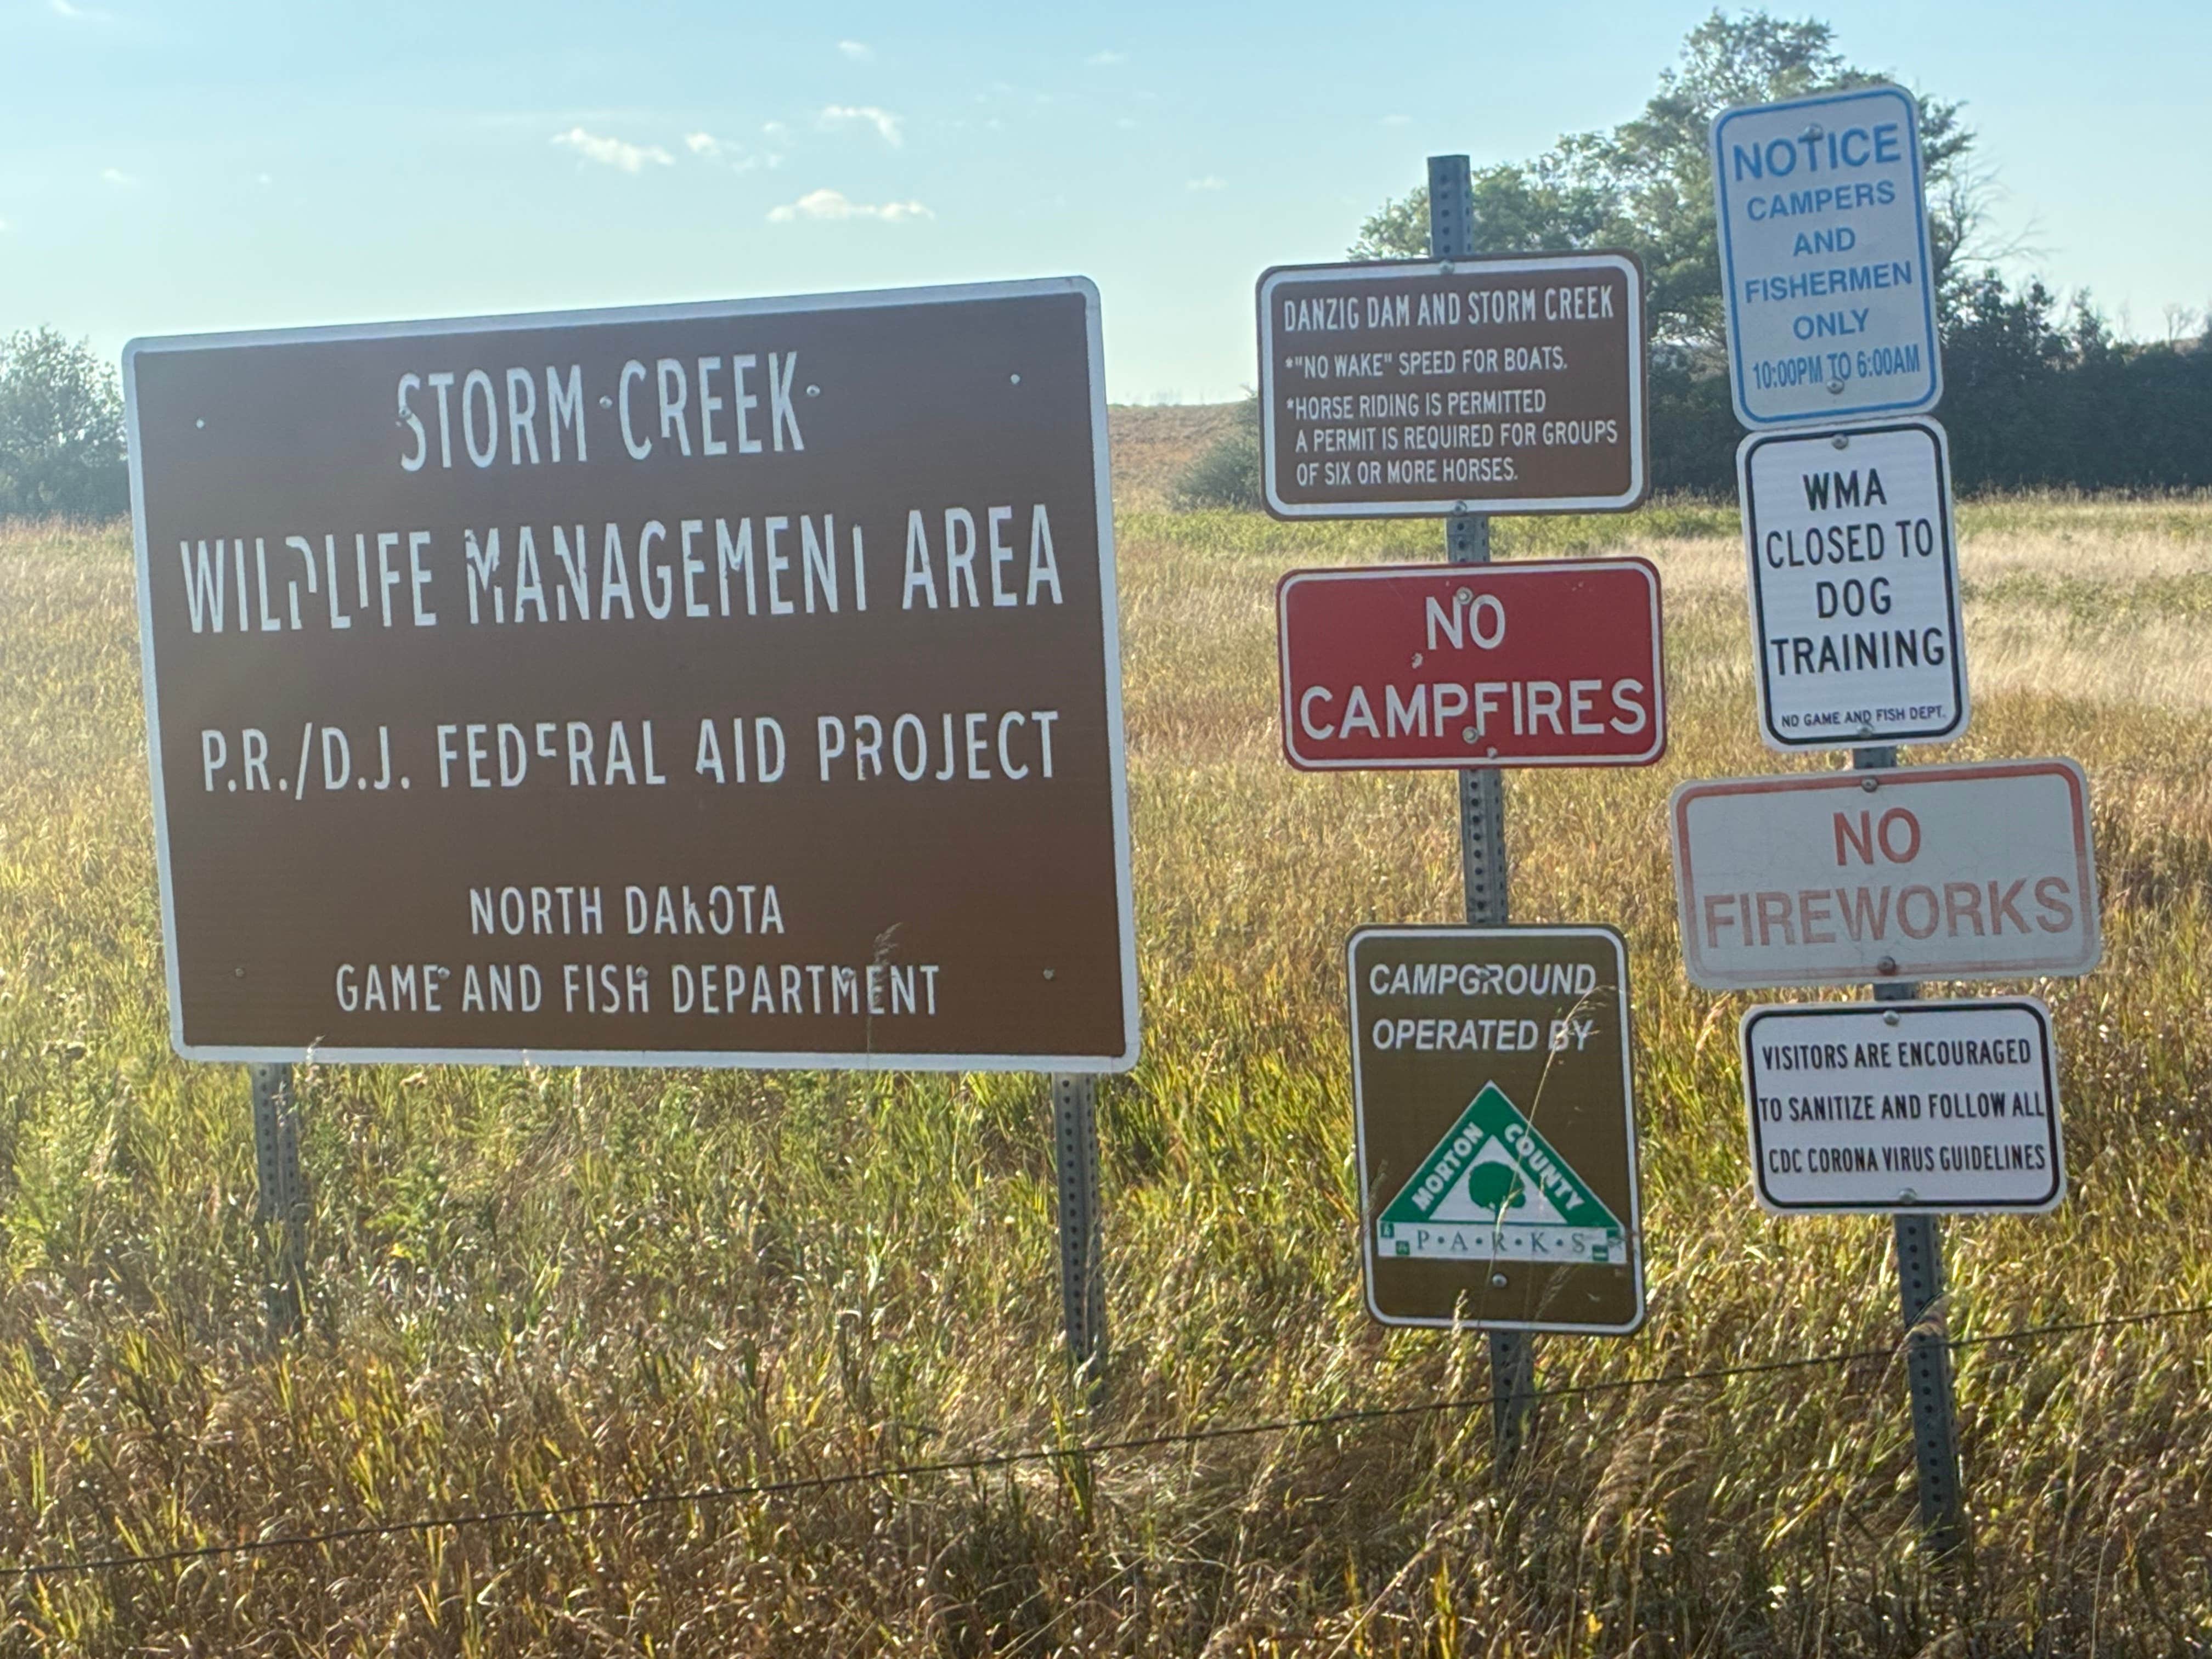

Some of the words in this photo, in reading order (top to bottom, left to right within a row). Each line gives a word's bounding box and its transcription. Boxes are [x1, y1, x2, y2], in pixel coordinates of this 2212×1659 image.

[1733, 123, 1901, 182] NOTICE
[1747, 180, 1895, 221] CAMPERS
[1793, 227, 1856, 256] AND
[1745, 261, 1912, 303] FISHERMEN
[1284, 297, 1358, 331] DANZIG
[1368, 294, 1409, 328] DAM
[1418, 292, 1460, 325] AND
[1469, 289, 1536, 324] STORM
[1545, 285, 1613, 320] CREEK
[1793, 308, 1869, 340] ONLY
[1334, 353, 1392, 377] WAKE"
[1399, 350, 1455, 376] SPEED
[1463, 348, 1497, 373] FOR
[1504, 346, 1567, 371] BOATS.
[1753, 356, 1822, 389] 10:00PM
[1827, 351, 1851, 381] TO
[1857, 344, 1920, 377] 6:00AM
[398, 364, 588, 472] STORM
[619, 351, 805, 461] CREEK
[1360, 393, 1419, 417] RIDING
[1426, 392, 1441, 415] IS
[1448, 390, 1545, 415] PERMITTED
[1296, 430, 1308, 452] A
[1314, 427, 1375, 452] PERMIT
[1383, 426, 1398, 450] IS
[1404, 424, 1493, 450] REQUIRED
[1501, 422, 1536, 447] FOR
[1542, 419, 1618, 445] GROUPS
[1296, 463, 1319, 486] OF
[1324, 462, 1351, 485] SIX
[1357, 461, 1380, 484] OR
[1388, 459, 1437, 483] MORE
[1443, 457, 1518, 483] HORSES.
[1803, 468, 1887, 511] WMA
[903, 503, 1063, 610] AREA
[1766, 523, 1884, 568] CLOSED
[1895, 518, 1933, 557] TO
[1816, 577, 1891, 618] DOG
[1426, 594, 1505, 650] NO
[1770, 627, 1944, 675] TRAINING
[1300, 678, 1646, 740] CAMPFIRES
[1781, 715, 1798, 727] ND
[1804, 712, 1840, 725] GAME
[1844, 709, 1871, 724] AND
[1877, 708, 1904, 722] FISH
[1910, 705, 1946, 720] DEPT.
[437, 719, 666, 788] FEDERAL
[695, 716, 786, 785] AID
[818, 710, 1059, 782] PROJECT
[1833, 807, 1920, 866] NO
[470, 885, 603, 935] NORTH
[626, 884, 785, 935] DAKOTA
[1703, 877, 2073, 948] FIREWORKS
[335, 964, 442, 1013] GAME
[461, 964, 541, 1013] AND
[562, 964, 649, 1013] FISH
[672, 964, 940, 1016] DEPARTMENT
[1370, 963, 1596, 996] CAMPGROUND
[1372, 1019, 1537, 1050] OPERATED
[1548, 1019, 1592, 1051] BY
[1762, 1044, 1848, 1070] VISITORS
[1854, 1042, 1890, 1068] ARE
[1898, 1038, 2030, 1068] ENCOURAGED
[1760, 1098, 1782, 1121] TO
[1789, 1095, 1875, 1121] SANITIZE
[1882, 1094, 1921, 1119] AND
[1929, 1092, 2006, 1118] FOLLOW
[2012, 1091, 2045, 1117] ALL
[1411, 1121, 1484, 1211] MORTON
[1503, 1124, 1585, 1210] COUNTY
[1769, 1147, 1802, 1173] CDC
[1808, 1146, 1878, 1173] CORONA
[1882, 1146, 1934, 1171] VIRUS
[1939, 1143, 2045, 1170] GUIDELINES
